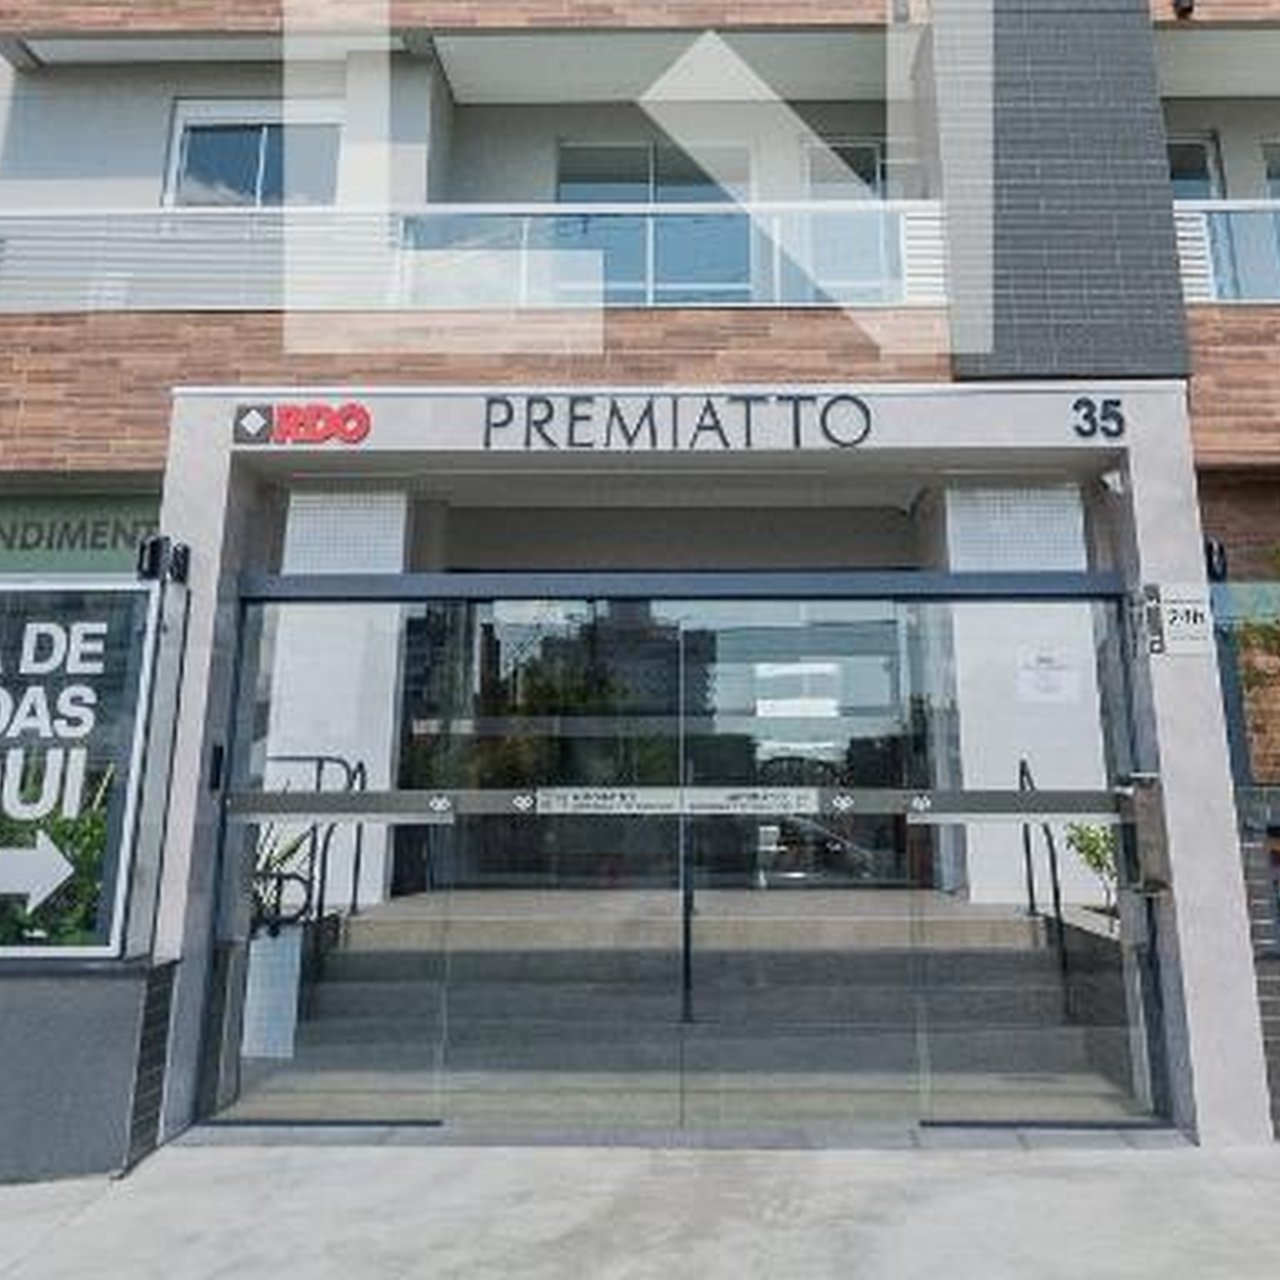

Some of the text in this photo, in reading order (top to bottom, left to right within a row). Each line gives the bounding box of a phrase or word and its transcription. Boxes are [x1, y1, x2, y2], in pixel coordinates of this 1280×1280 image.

[274, 402, 372, 444] RDO
[484, 394, 871, 448] PREMIATTO
[1073, 397, 1125, 439] 35
[19, 622, 108, 674] DE
